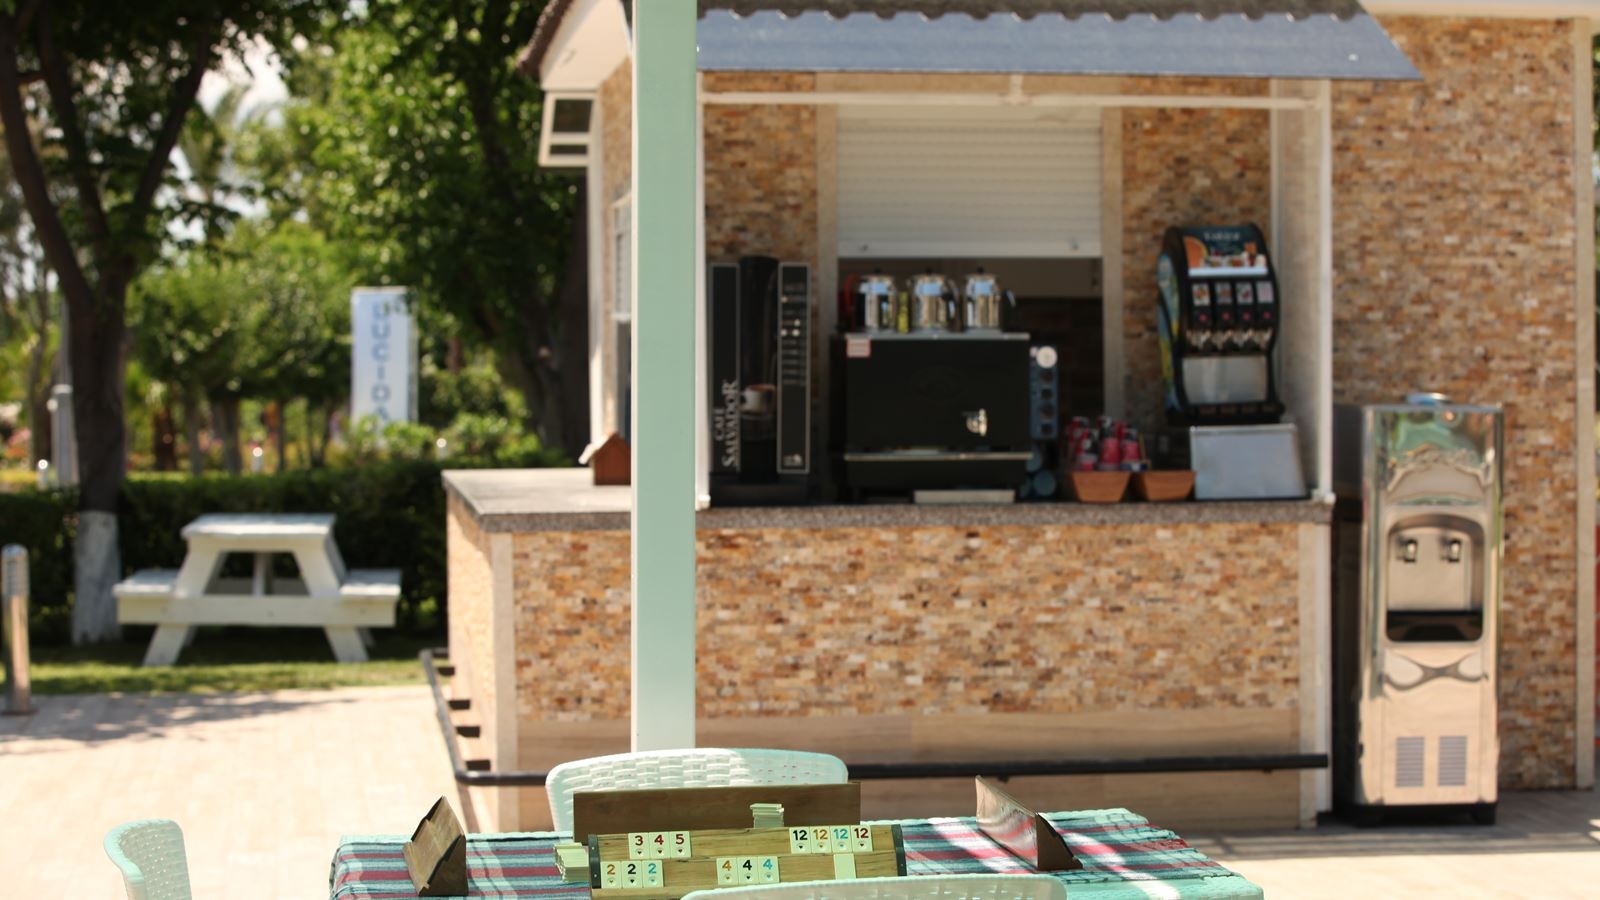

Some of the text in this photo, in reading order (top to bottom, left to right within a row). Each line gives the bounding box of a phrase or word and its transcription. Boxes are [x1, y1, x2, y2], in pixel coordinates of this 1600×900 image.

[635, 833, 684, 846] 3 4 5
[793, 828, 869, 841] 12 12 12 12
[607, 863, 656, 875] 2 2 2
[722, 859, 772, 871] 4 4 4
